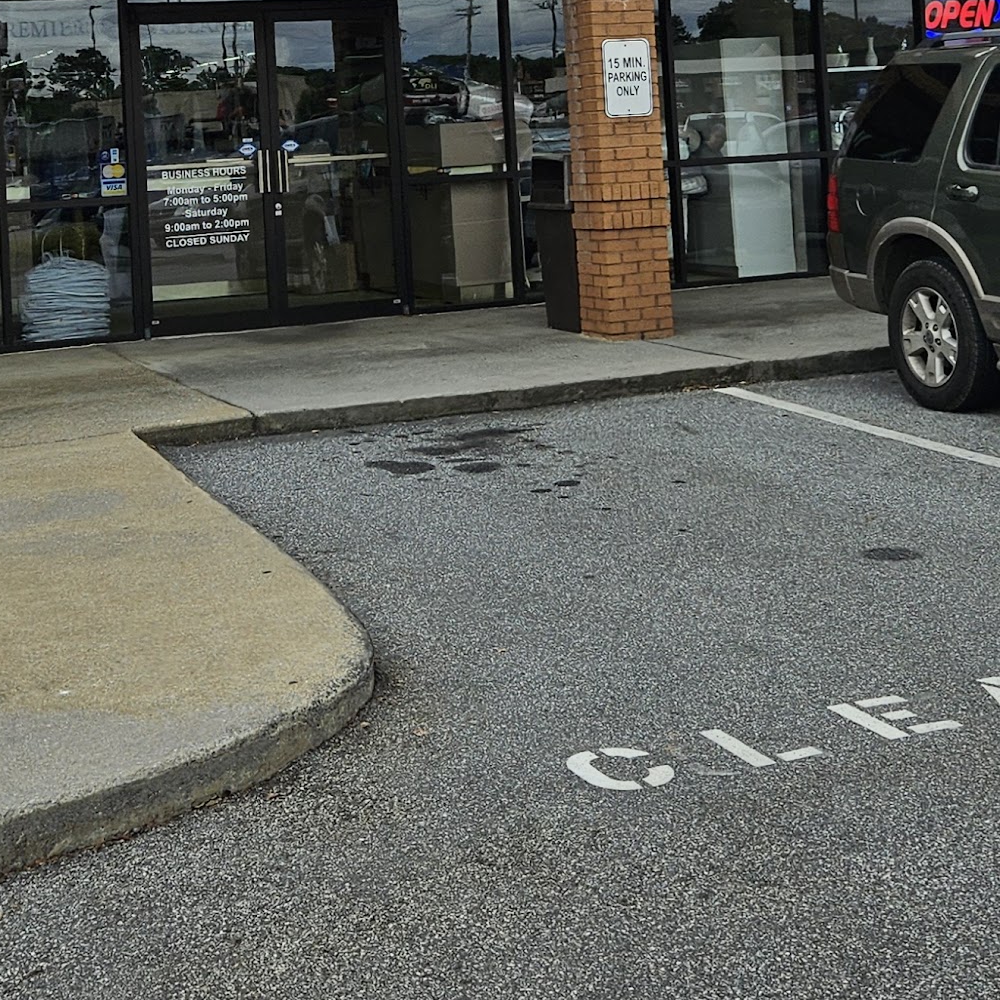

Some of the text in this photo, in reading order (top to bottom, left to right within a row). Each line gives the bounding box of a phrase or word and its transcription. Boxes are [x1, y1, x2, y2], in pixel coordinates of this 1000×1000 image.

[924, 0, 996, 29] OPEN
[608, 56, 646, 69] 15 MIN.
[608, 71, 647, 83] PARKING
[616, 85, 640, 97] ONLY
[161, 166, 247, 180] BUSINESS HOURS
[106, 183, 123, 191] VISA
[167, 185, 205, 196] Monday
[213, 182, 244, 194] Friday
[163, 193, 248, 207] 7:00am to 5:00pm
[184, 207, 228, 219] Saturday
[164, 218, 250, 233] 9:00am to 2:00pm
[165, 233, 250, 248] CLOSED SUNDAY
[566, 676, 1000, 790] CLE
